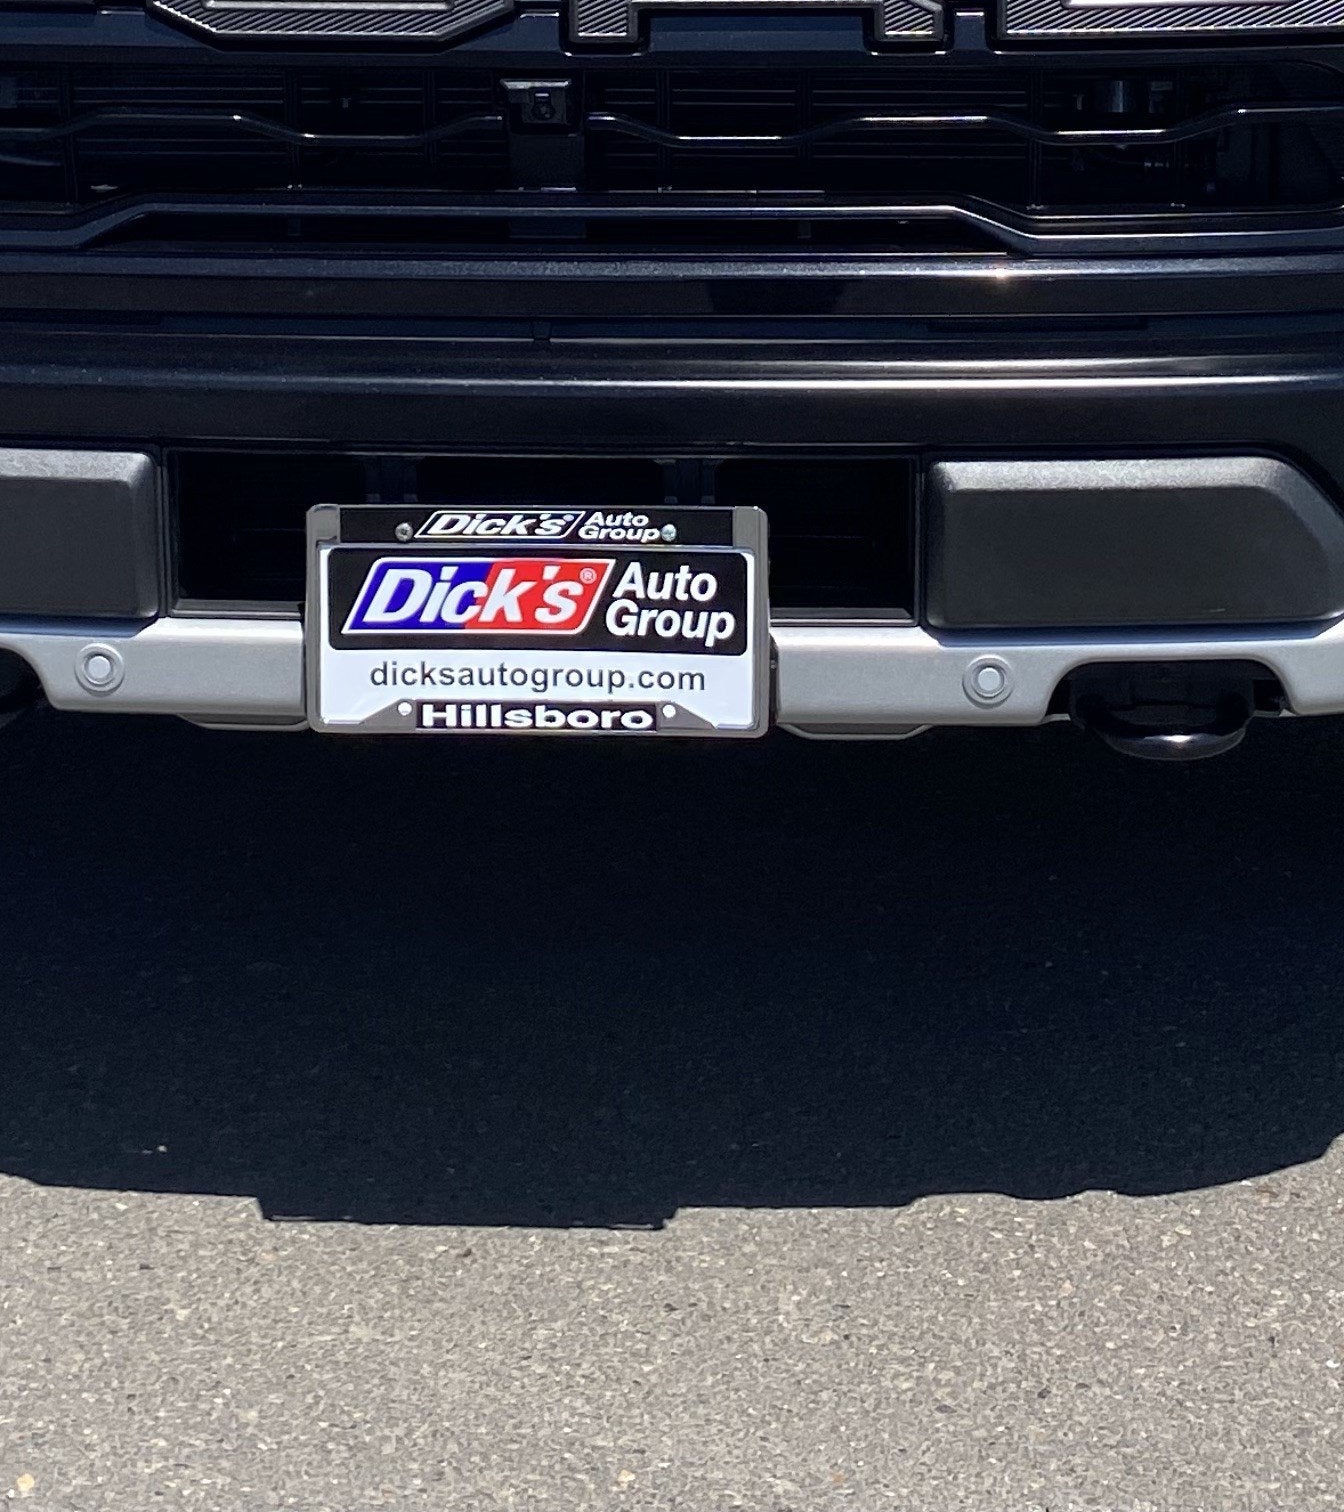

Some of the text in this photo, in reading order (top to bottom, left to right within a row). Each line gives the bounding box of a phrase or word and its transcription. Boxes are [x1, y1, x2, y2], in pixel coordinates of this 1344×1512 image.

[427, 513, 566, 536] Dick's
[578, 524, 660, 543] Group
[584, 511, 649, 527] Auto
[362, 564, 583, 624] Dick's
[611, 561, 717, 602] Auto
[605, 599, 735, 648] Group
[369, 660, 706, 693] dicksautogroup.com
[422, 703, 654, 730] Hillsboro
